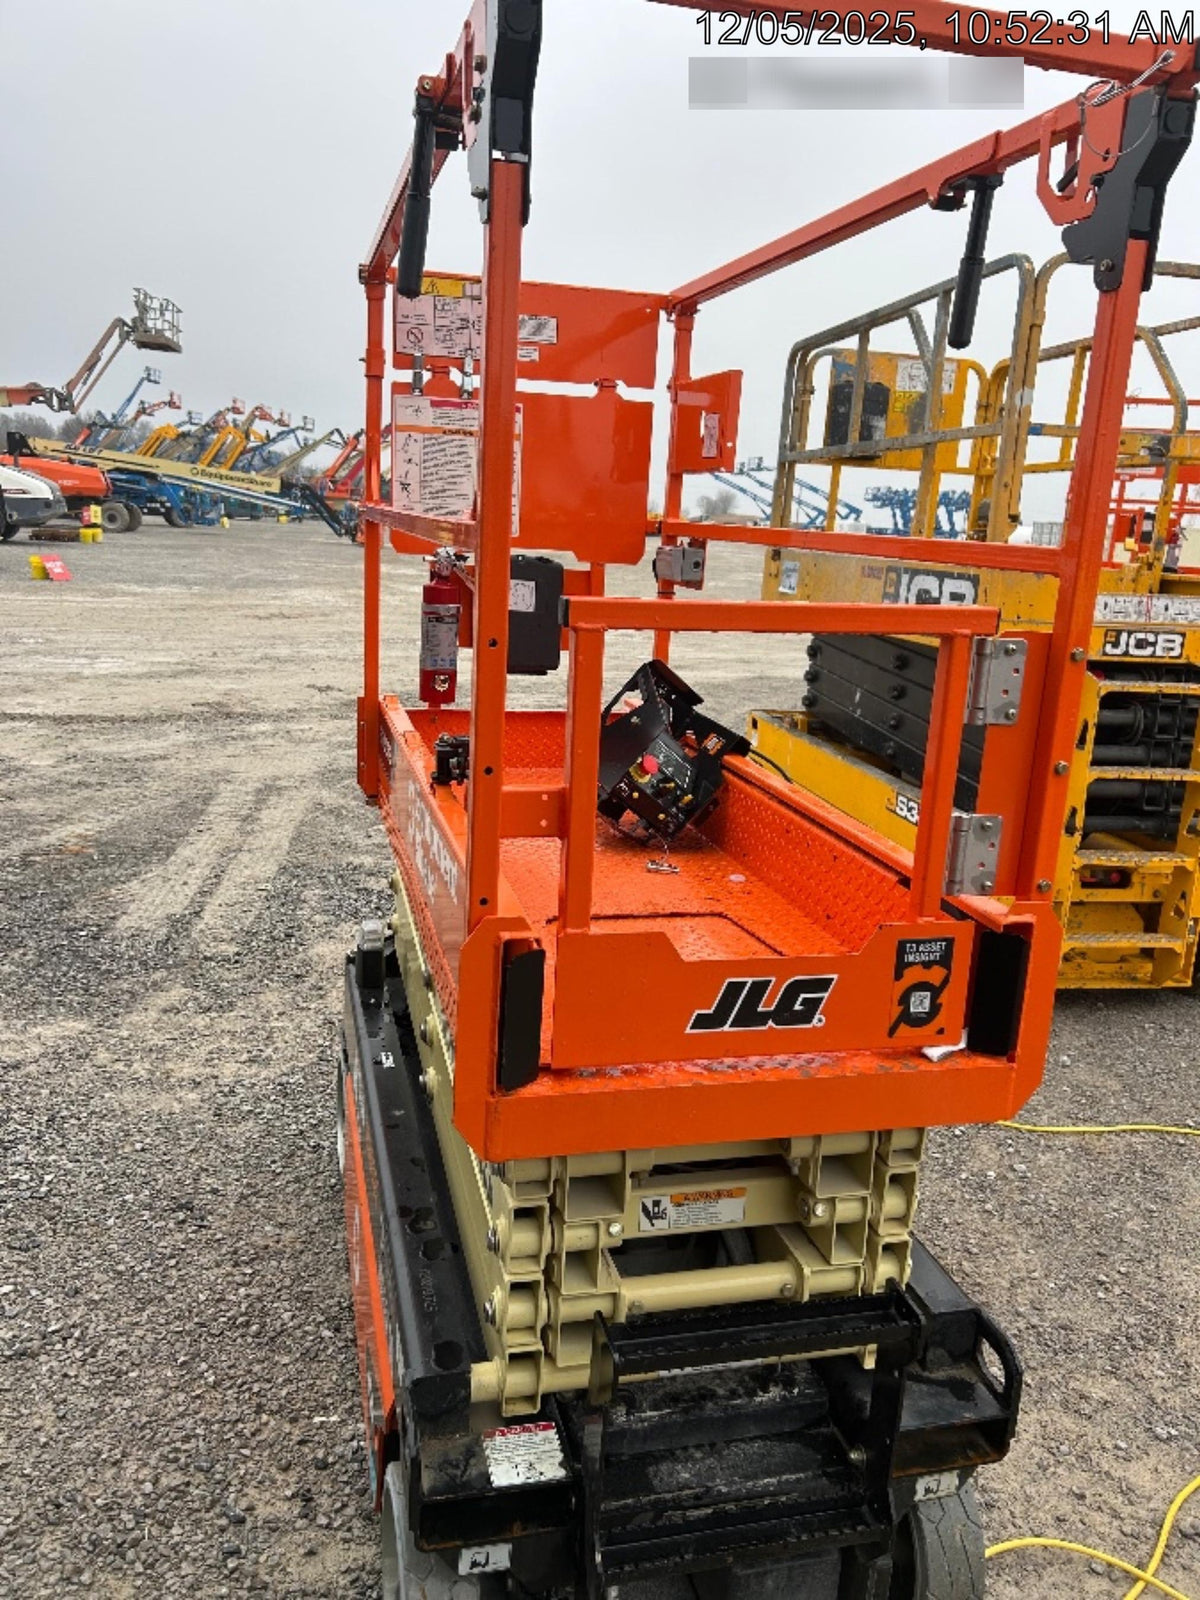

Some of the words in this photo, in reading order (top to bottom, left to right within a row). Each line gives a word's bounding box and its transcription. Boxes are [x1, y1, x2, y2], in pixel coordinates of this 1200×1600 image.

[1104, 630, 1184, 657] JCB
[919, 941, 947, 952] ASSET
[904, 952, 941, 963] INSIGHT
[685, 974, 838, 1034] JLG
